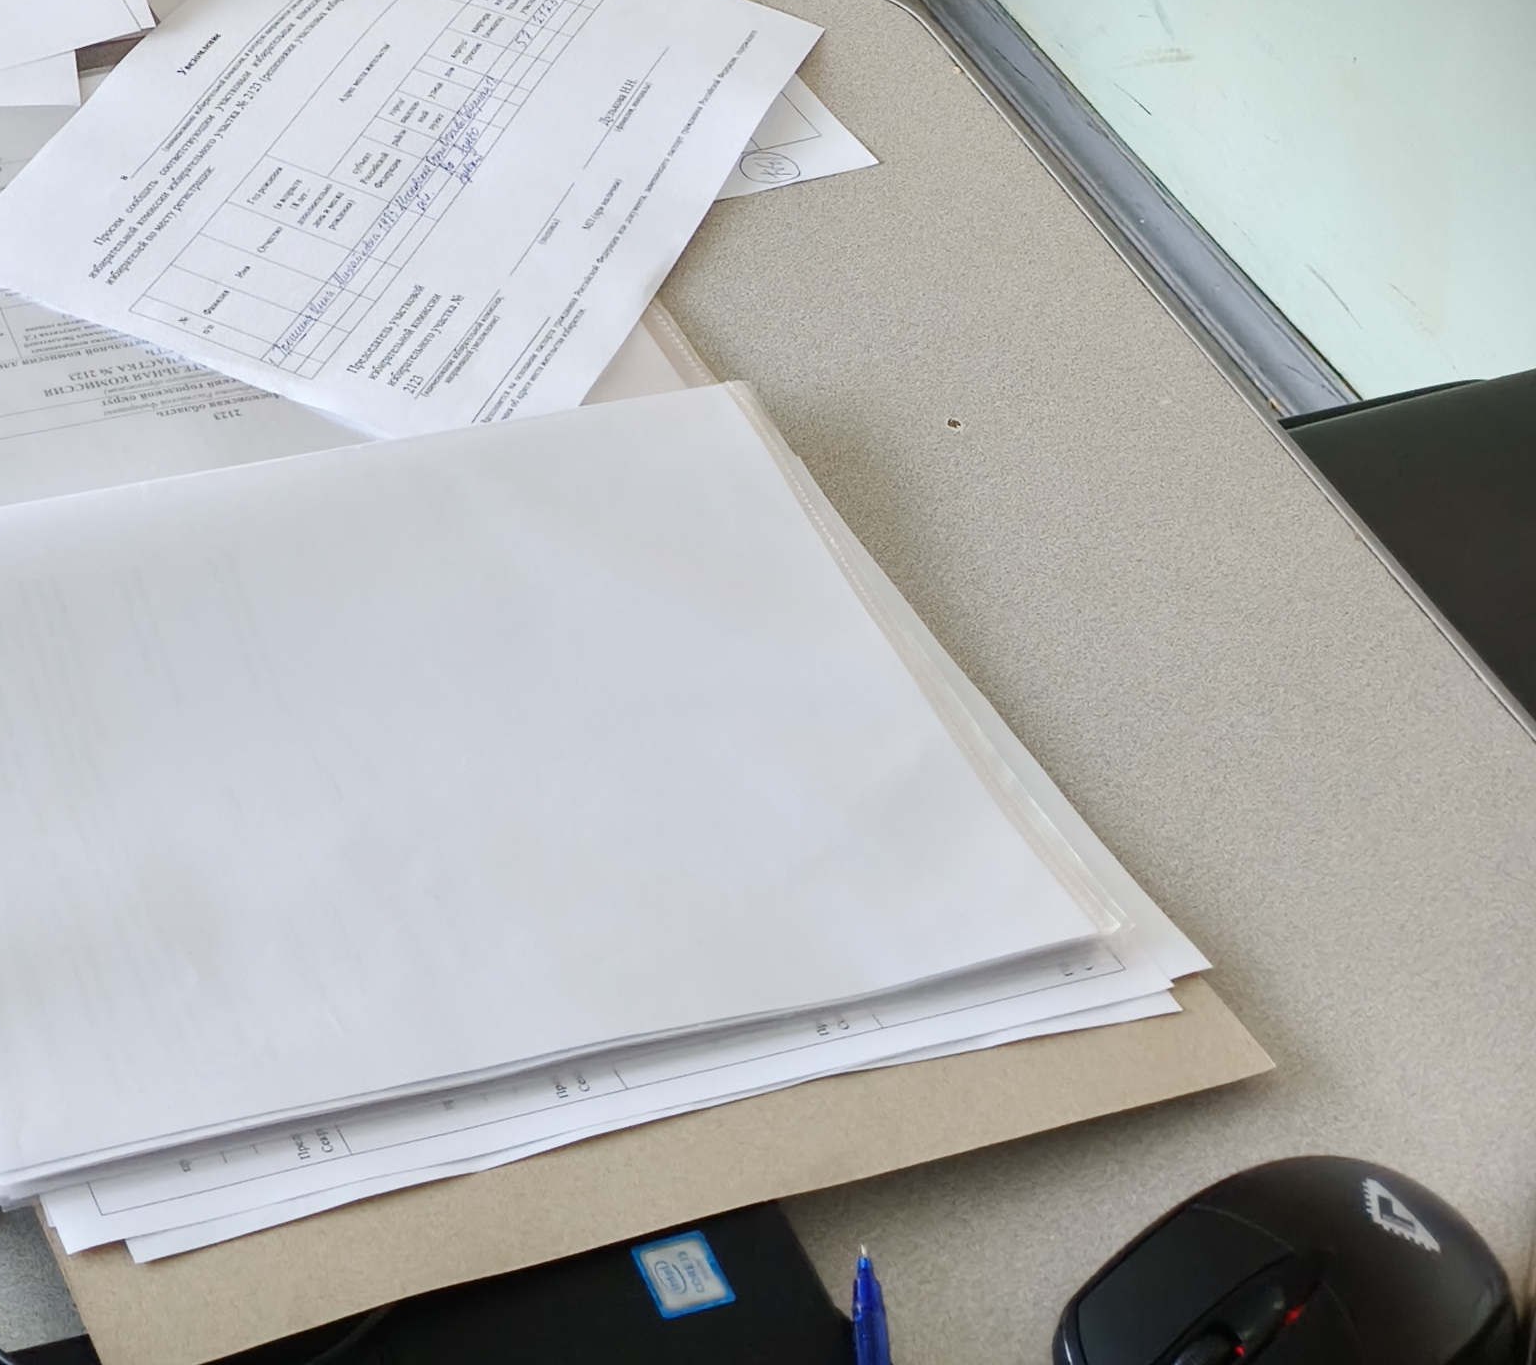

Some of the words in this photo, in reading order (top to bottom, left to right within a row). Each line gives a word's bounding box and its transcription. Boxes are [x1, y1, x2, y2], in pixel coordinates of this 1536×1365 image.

[177, 34, 221, 73] Уведомление
[596, 94, 630, 125] Дулькова
[86, 227, 138, 277] избирательной
[135, 192, 169, 225] комиссии
[165, 139, 217, 189] избирательного
[211, 110, 244, 137] участка
[242, 82, 264, 98] 2123
[93, 217, 126, 245] Просим
[123, 179, 158, 212] сообщить
[157, 116, 217, 174] соответствующим
[104, 241, 149, 284] избирателей
[143, 230, 159, 241] по
[152, 210, 178, 231] месту
[256, 226, 283, 252] Отчество
[234, 264, 251, 278] Имя
[348, 325, 393, 372] Председатель
[387, 285, 426, 324] участковой
[368, 329, 413, 378] избирательной
[410, 294, 441, 327] комиссии
[386, 332, 434, 385] избирательного
[430, 305, 459, 332] участка
[449, 293, 464, 304] №
[42, 373, 129, 397] КОМИССИЯ
[67, 369, 96, 381] 2123
[136, 380, 203, 401] городской
[403, 375, 423, 392] 2123
[100, 393, 137, 407] округ
[155, 402, 207, 419] область
[211, 408, 241, 420] 2123
[660, 1261, 680, 1292] intel
[683, 1262, 705, 1295] CORE
